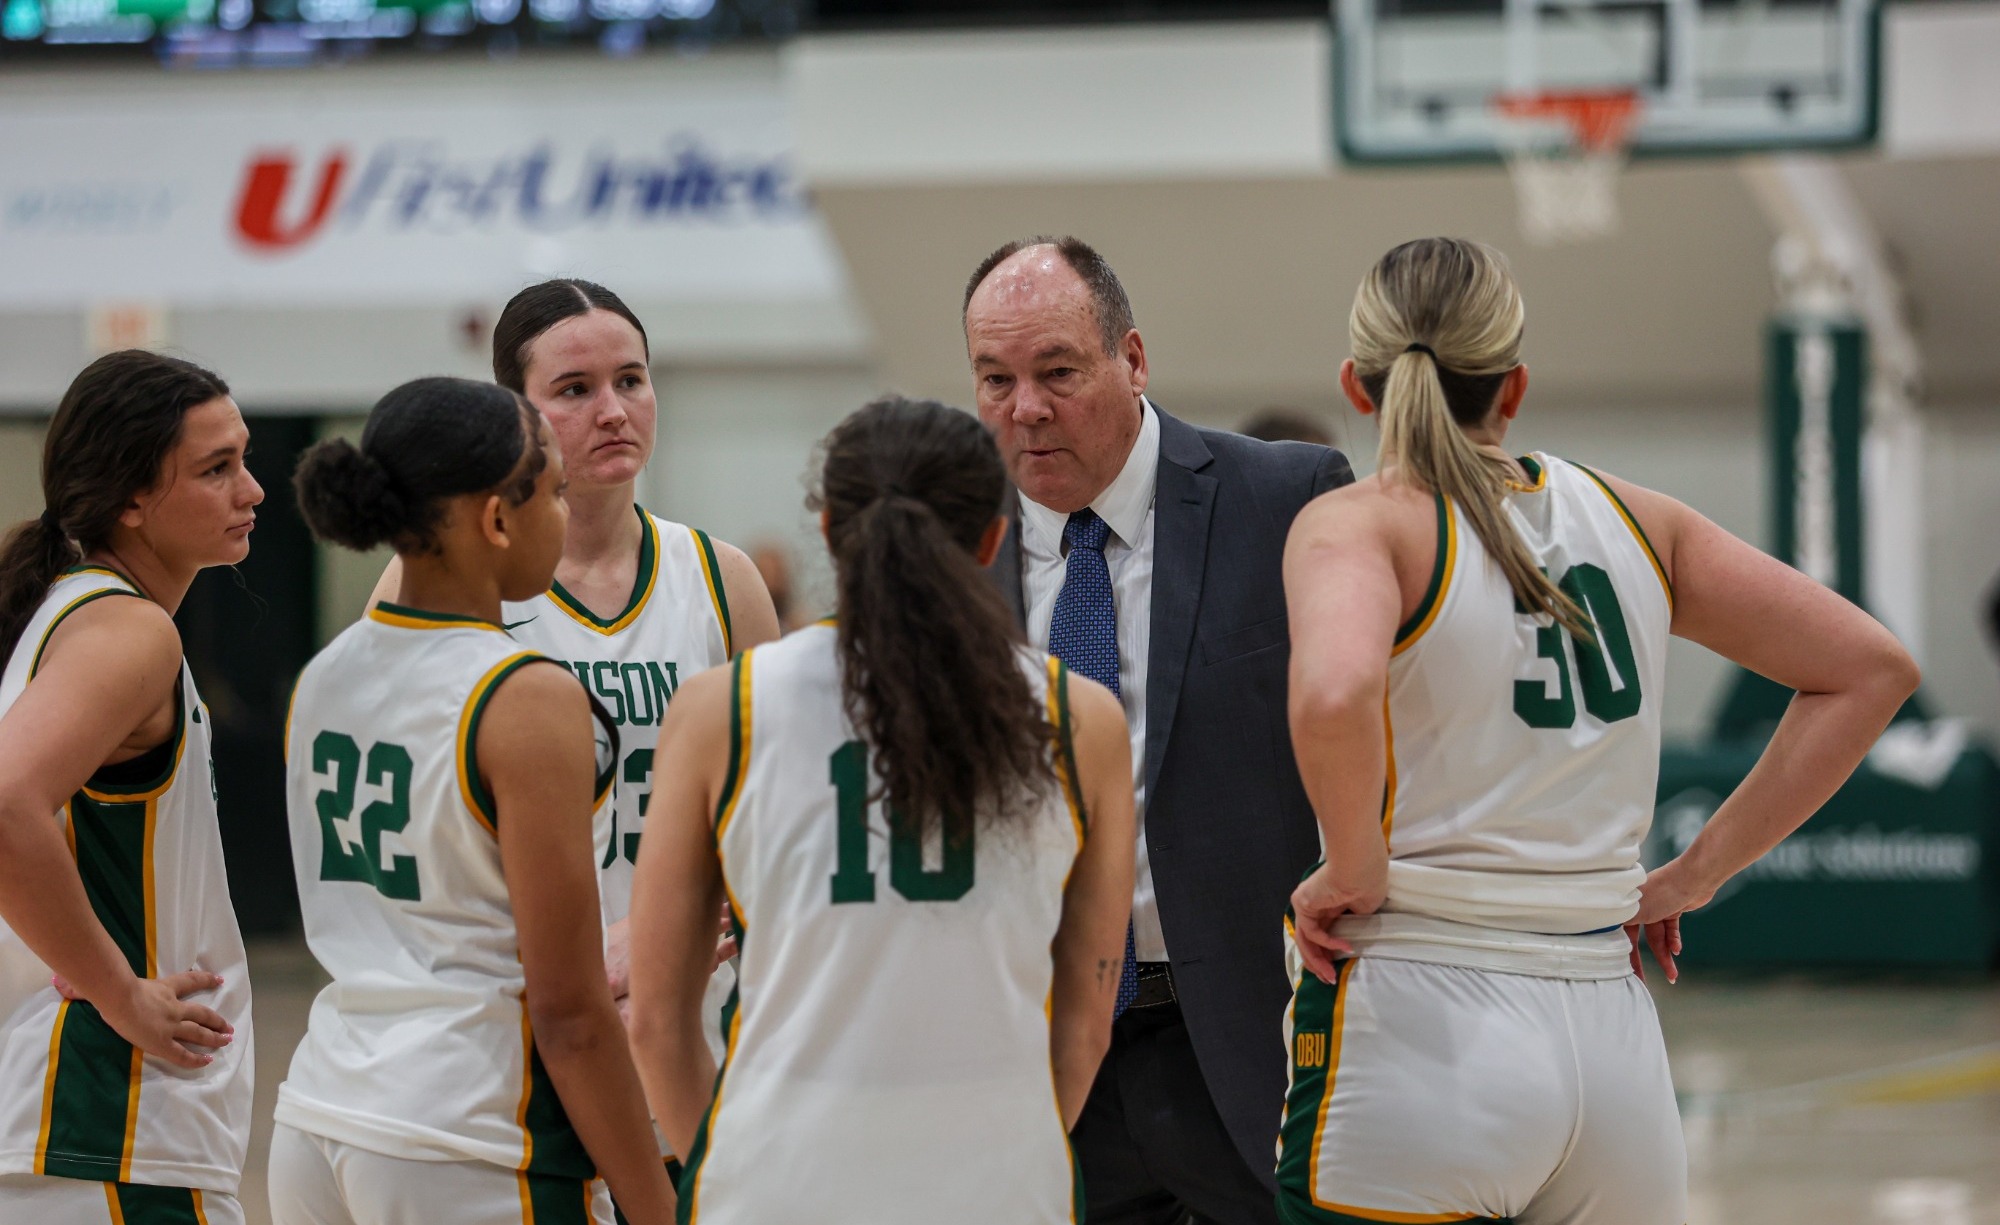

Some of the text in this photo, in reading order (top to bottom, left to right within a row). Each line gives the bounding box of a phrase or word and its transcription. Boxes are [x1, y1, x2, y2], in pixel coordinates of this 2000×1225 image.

[232, 149, 349, 252] U
[559, 660, 679, 726] ISON
[1513, 562, 1642, 729] 30
[312, 730, 421, 901] 22
[829, 740, 976, 905] 10
[1297, 1033, 1325, 1067] OBU
